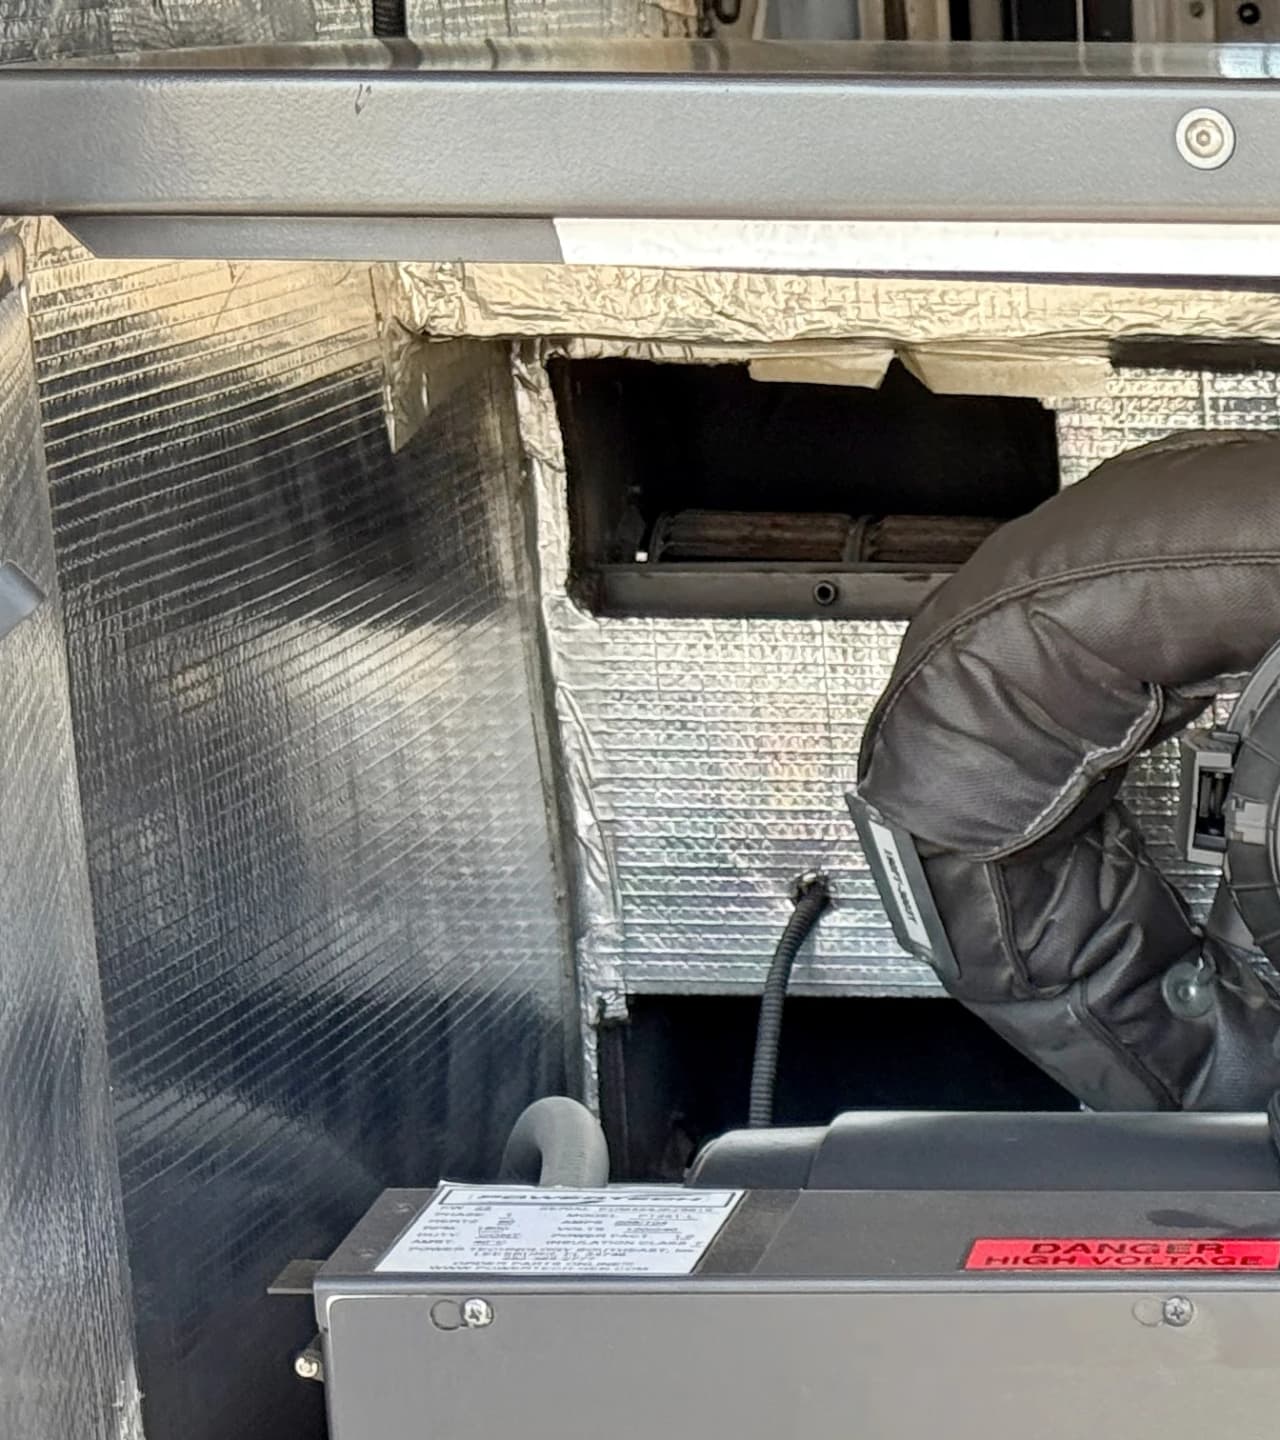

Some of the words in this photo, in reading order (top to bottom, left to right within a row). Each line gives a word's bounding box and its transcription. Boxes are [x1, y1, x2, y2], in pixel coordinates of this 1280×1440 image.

[1030, 1242, 1225, 1255] DANGER
[984, 1255, 1069, 1266] HIGH
[1089, 1255, 1264, 1266] VOLTAGE
